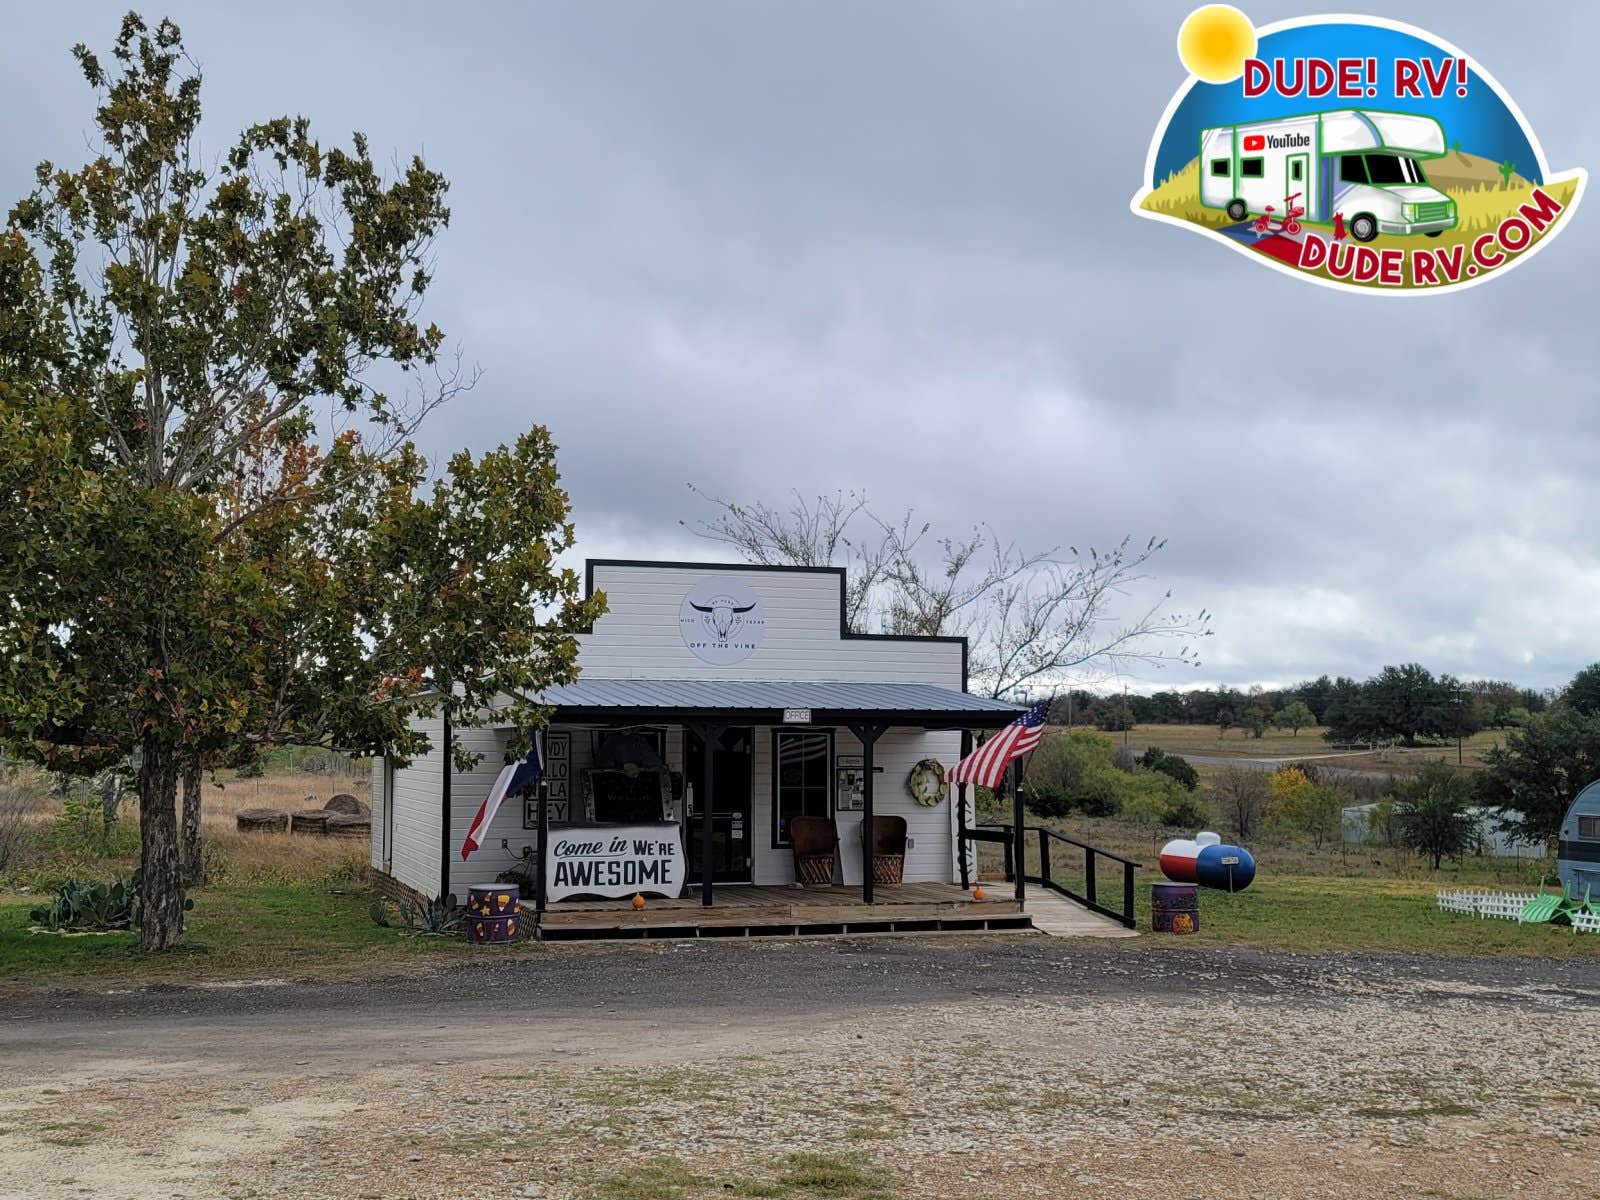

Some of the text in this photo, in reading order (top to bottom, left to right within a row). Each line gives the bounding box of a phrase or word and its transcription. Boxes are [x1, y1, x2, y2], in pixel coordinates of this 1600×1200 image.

[786, 711, 809, 720] OFFICE
[553, 836, 675, 857] Come in WE'RE
[553, 859, 673, 887] AWESOME
